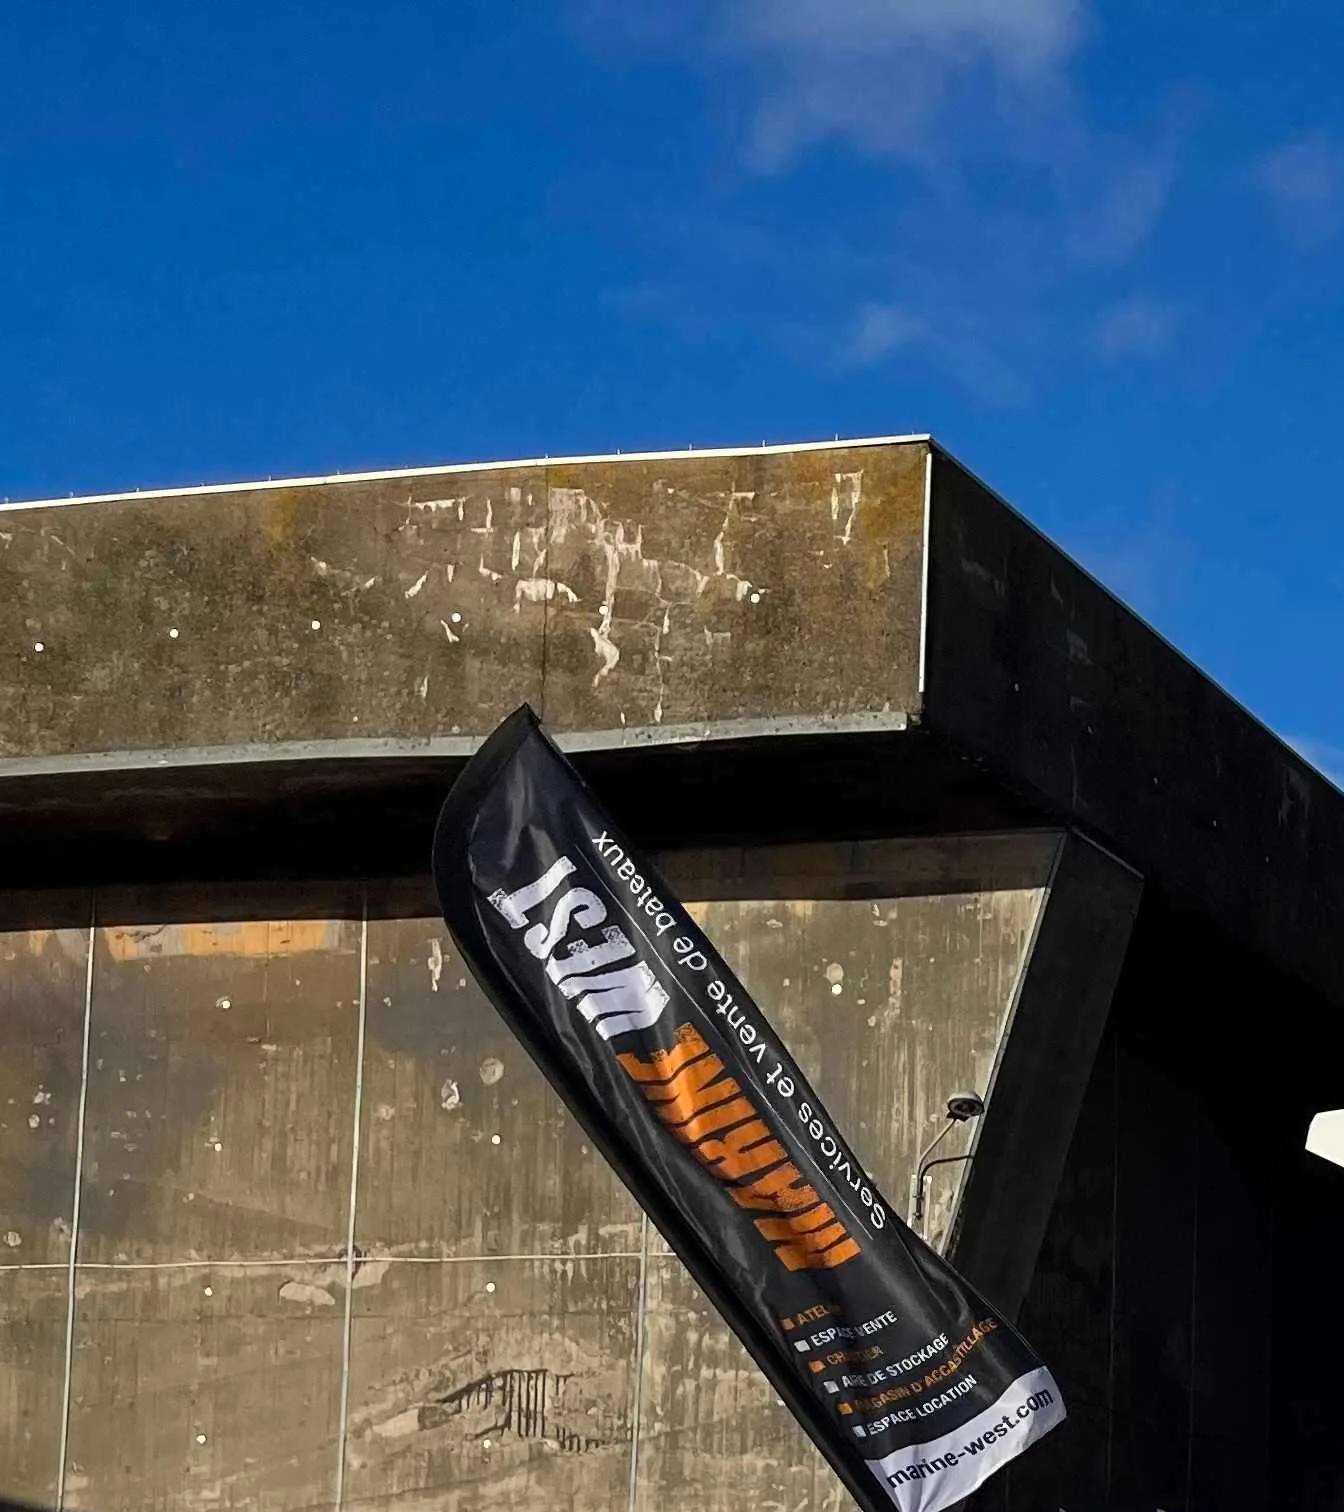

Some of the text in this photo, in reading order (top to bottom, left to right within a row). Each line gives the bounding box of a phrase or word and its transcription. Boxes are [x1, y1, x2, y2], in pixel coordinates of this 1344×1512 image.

[487, 856, 862, 1272] MARINE WEST
[591, 830, 887, 1230] Services et vente de bateaux
[867, 1374, 978, 1436] ESPACE LOCATION
[868, 1369, 887, 1385] DE
[887, 1332, 950, 1378] STOCKAGE
[886, 1387, 1055, 1489] marine-west.com
